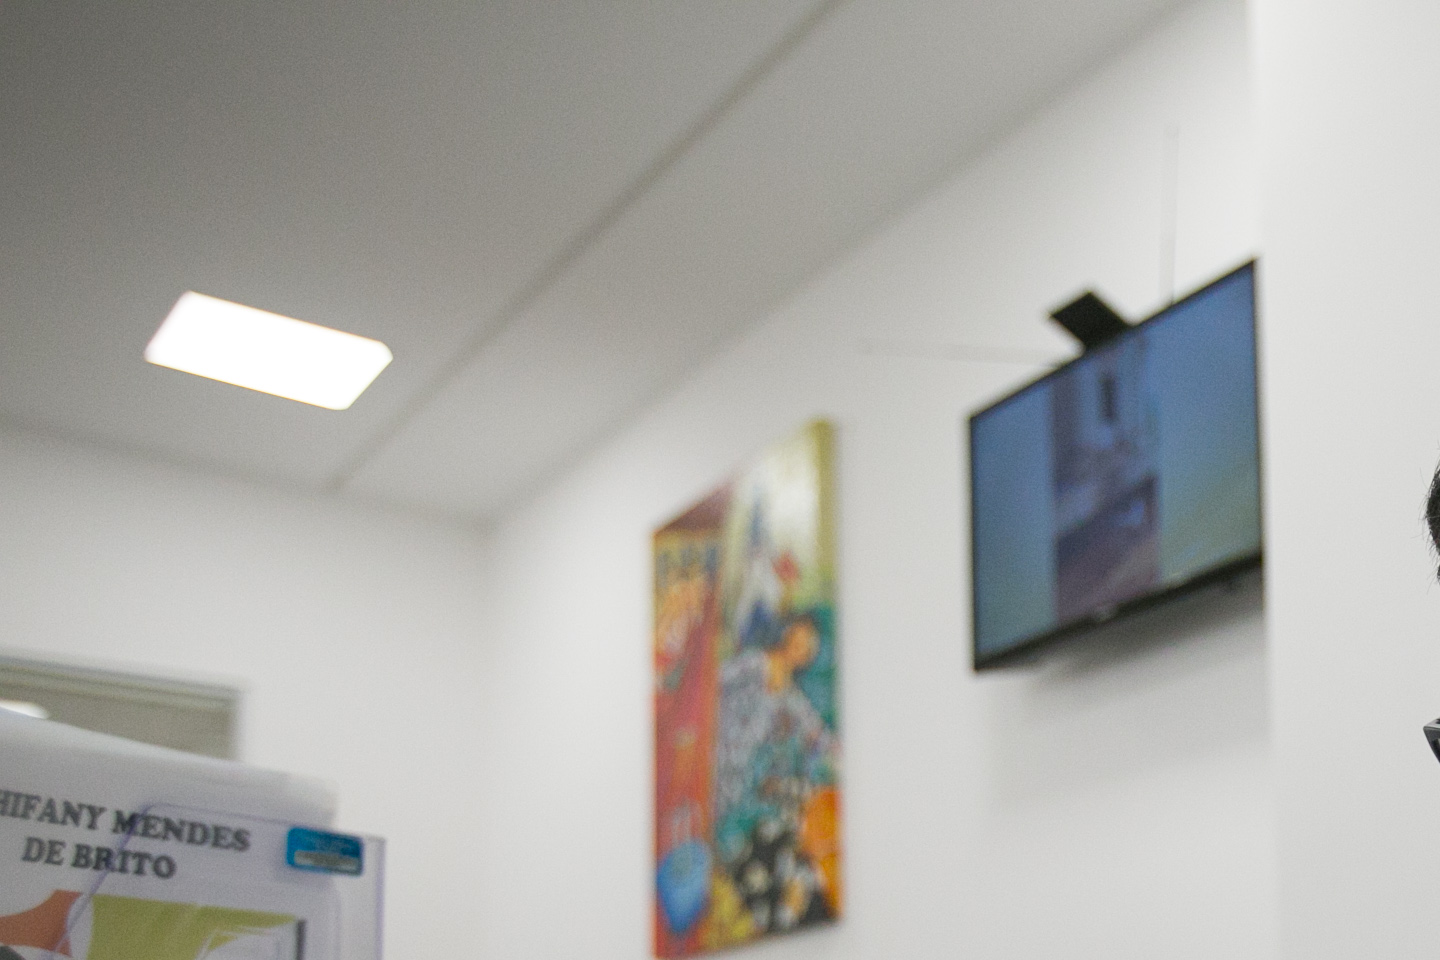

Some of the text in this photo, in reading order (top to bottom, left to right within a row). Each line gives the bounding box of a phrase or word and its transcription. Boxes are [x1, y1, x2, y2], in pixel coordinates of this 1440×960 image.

[112, 809, 251, 852] MENDES
[21, 836, 177, 880] DE BRITO
